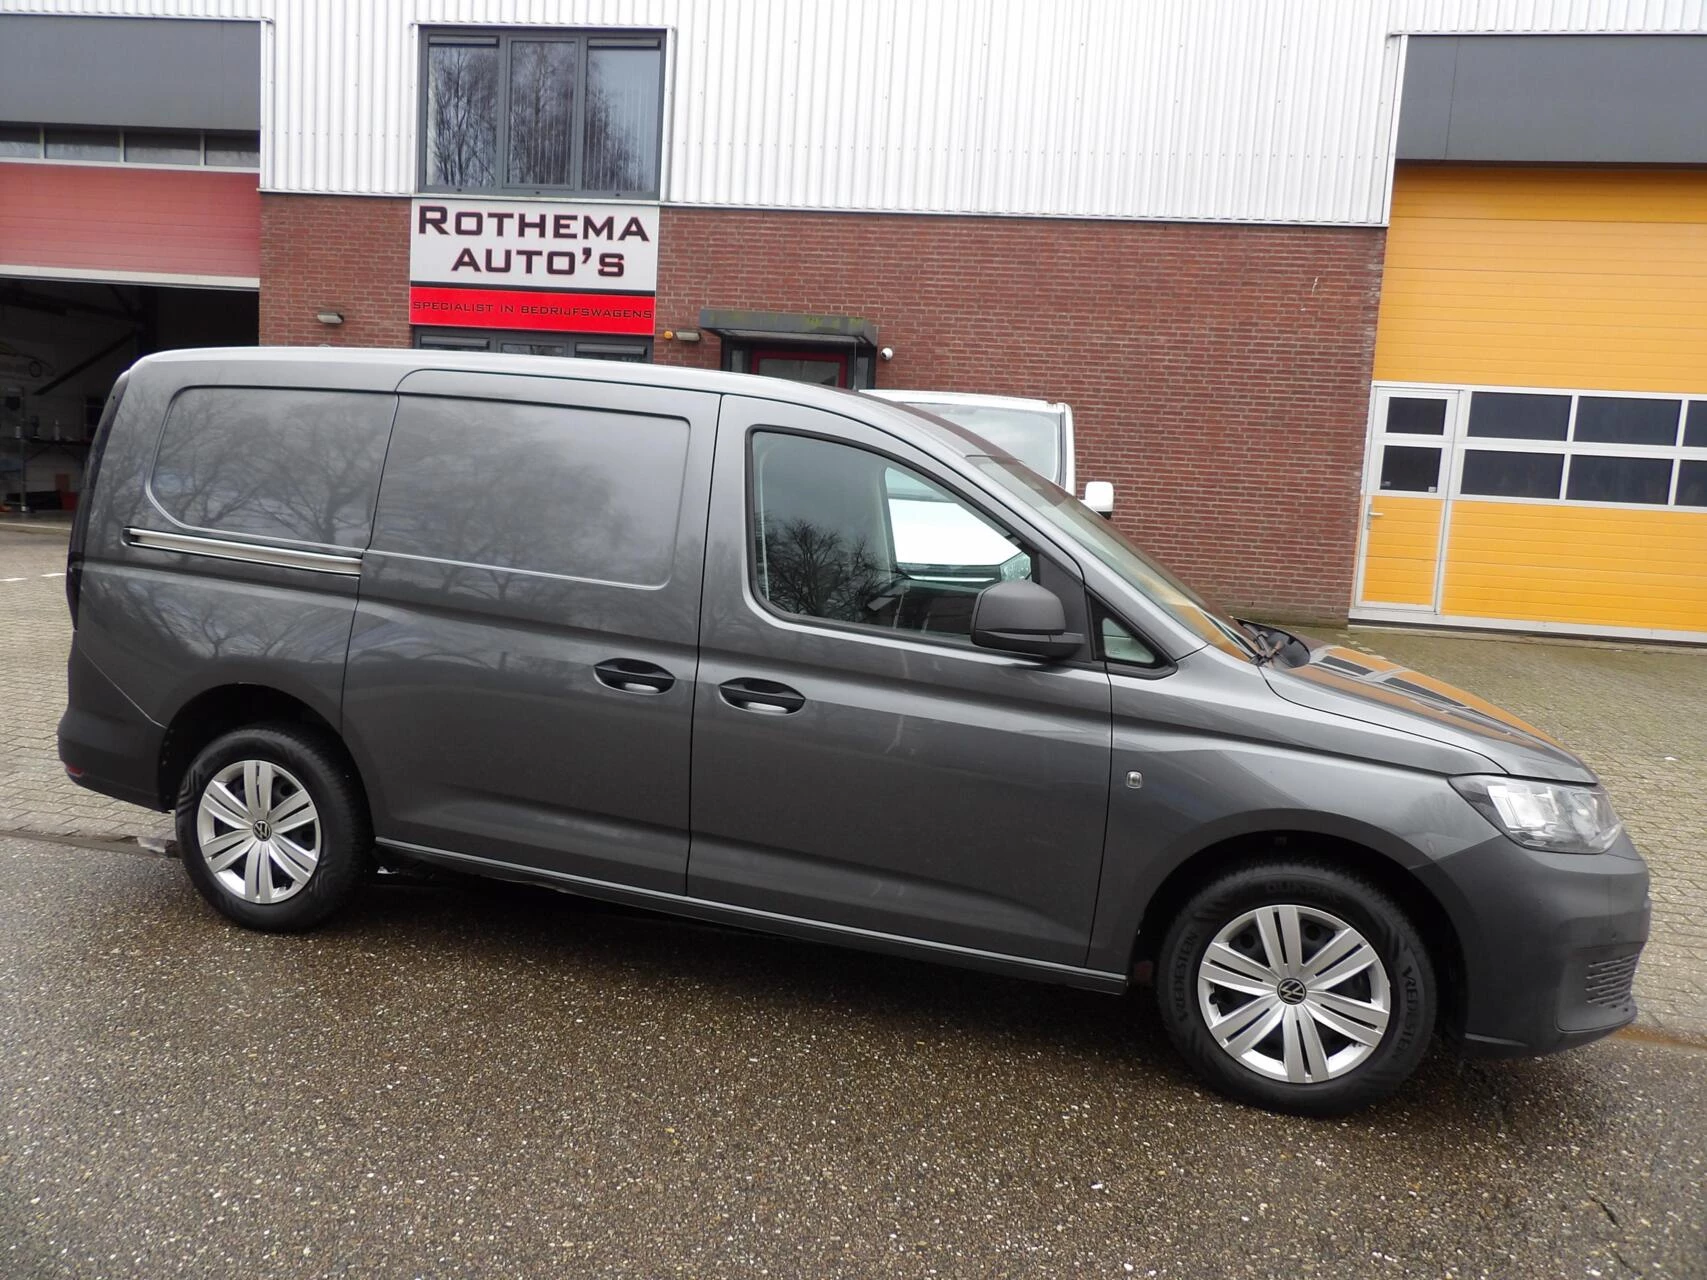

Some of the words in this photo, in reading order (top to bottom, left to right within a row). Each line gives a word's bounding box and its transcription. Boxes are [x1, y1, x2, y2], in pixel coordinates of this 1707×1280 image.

[418, 205, 650, 242] ROTHEMA
[450, 247, 625, 277] AUTO'S
[413, 301, 494, 313] SPECIALIST
[500, 304, 514, 313] IN
[520, 306, 653, 319] BEDRIJFSWAGENS
